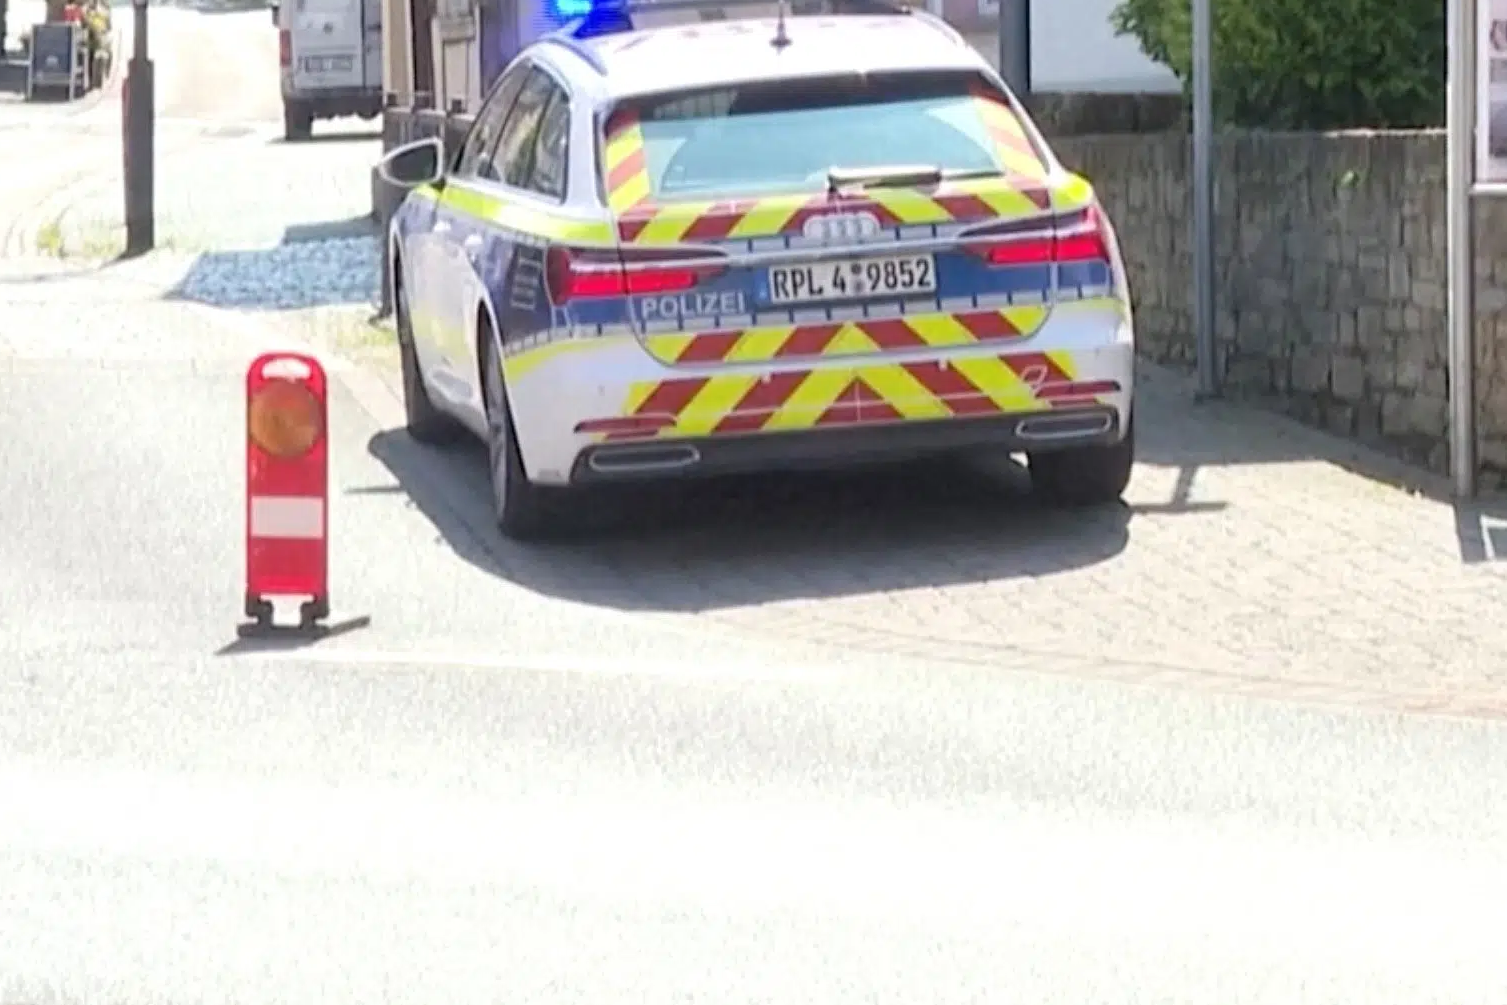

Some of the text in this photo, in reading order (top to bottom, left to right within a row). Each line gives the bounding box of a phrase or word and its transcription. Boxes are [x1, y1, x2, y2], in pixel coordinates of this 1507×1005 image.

[773, 267, 824, 300] RPL
[865, 258, 932, 290] 9852
[642, 292, 744, 319] POLIZEI
